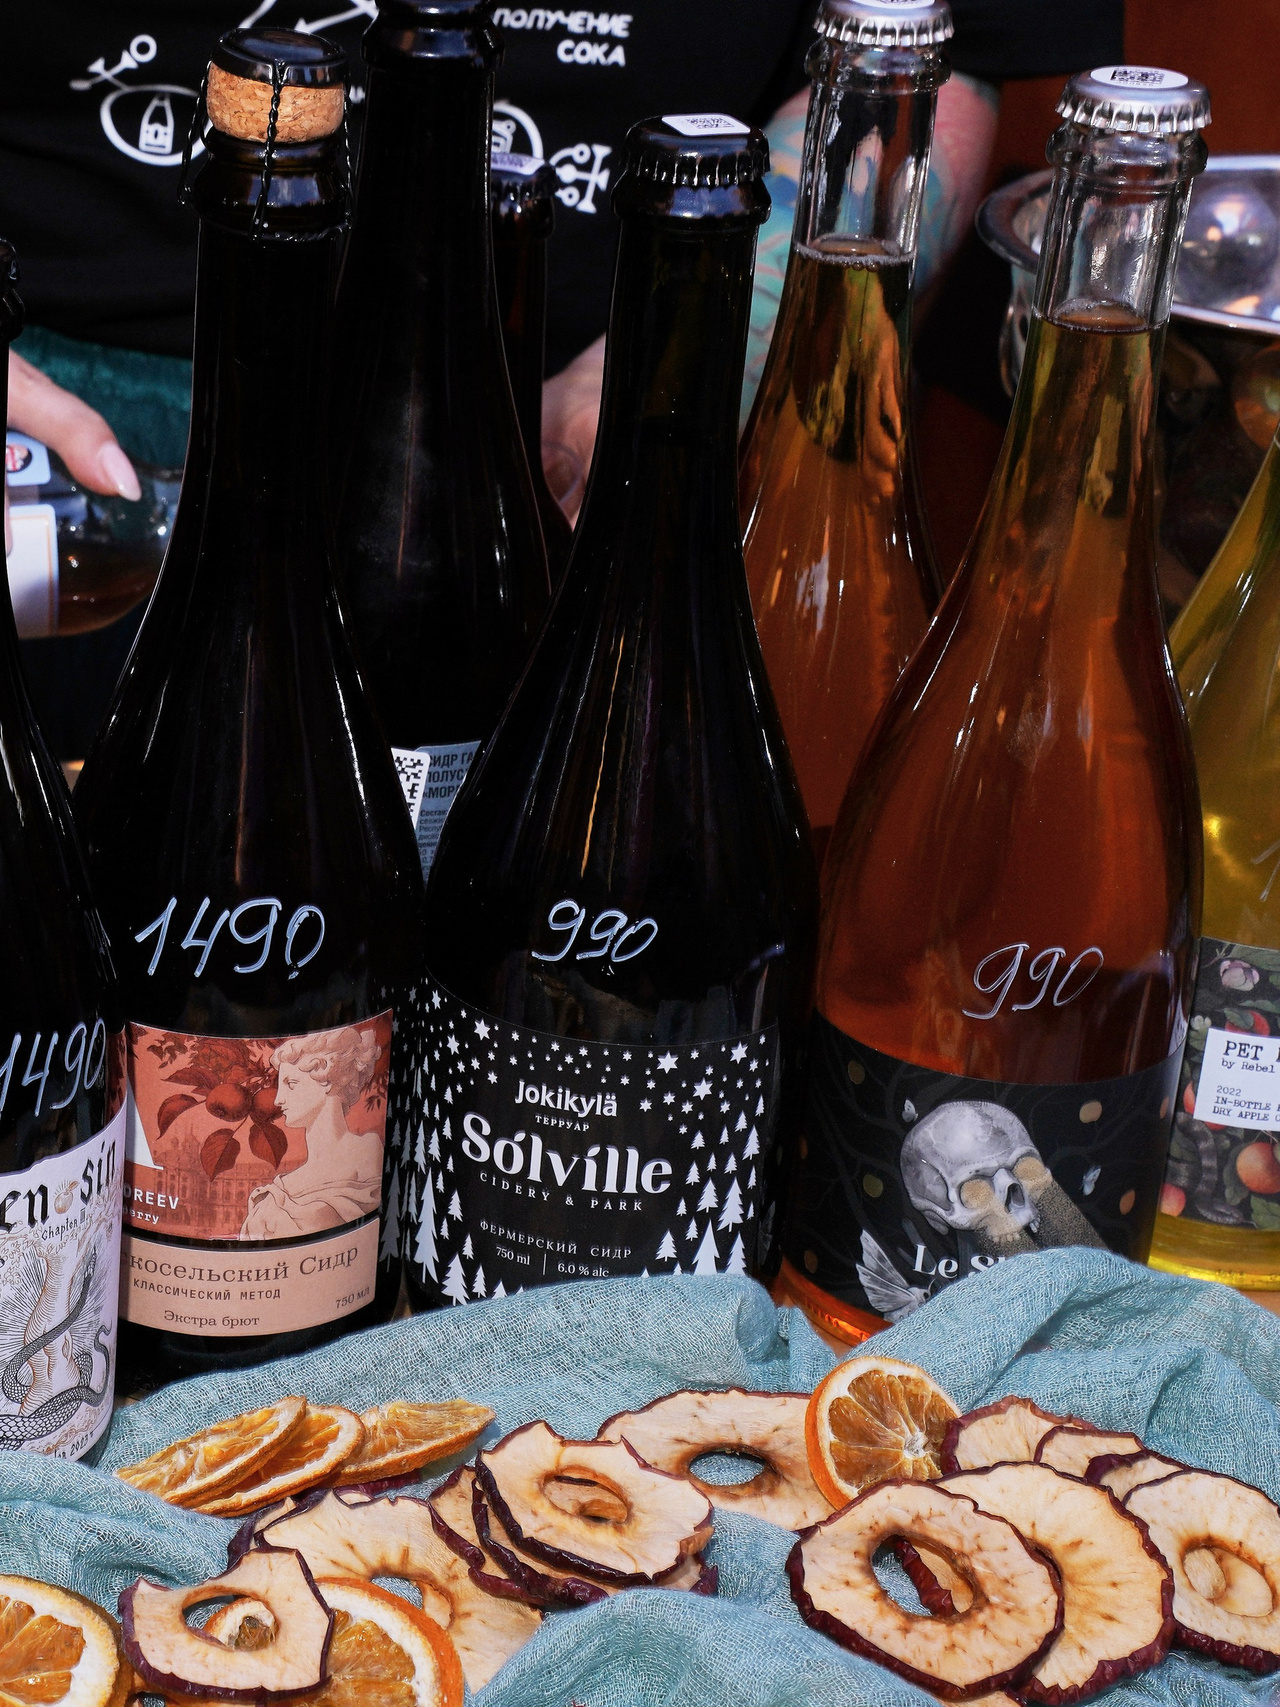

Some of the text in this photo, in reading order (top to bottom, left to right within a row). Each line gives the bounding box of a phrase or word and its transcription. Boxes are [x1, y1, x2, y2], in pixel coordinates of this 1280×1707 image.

[492, 8, 632, 38] ПОЛУЧЕНИЕ
[557, 39, 626, 67] СОКА
[135, 896, 325, 980] 1490
[531, 898, 659, 963] 990
[962, 942, 1105, 1022] 990
[1223, 1040, 1264, 1061] PET
[1221, 1058, 1275, 1074] by Rebel
[514, 1079, 618, 1117] Jokikylä
[1214, 1096, 1271, 1111] IN-BOTTLE
[1216, 1085, 1242, 1096] 2022
[535, 1114, 590, 1131] ТЕРРУАР
[1212, 1106, 1232, 1116] DRY
[1237, 1111, 1270, 1121] APPLE
[480, 1171, 643, 1211] CIDERY & PARK
[480, 1219, 632, 1259] ФЕРМЕРСКИЙ СИДР
[299, 1247, 359, 1275] Сидр
[495, 1247, 610, 1277] 750 ml 6.0 % alc
[913, 1244, 1006, 1279] Le S
[133, 1278, 281, 1301] КЛАССИЧЕСКИЙ МЕТОД
[335, 1289, 370, 1309] 750 мл
[164, 1309, 260, 1329] Экстра брют
